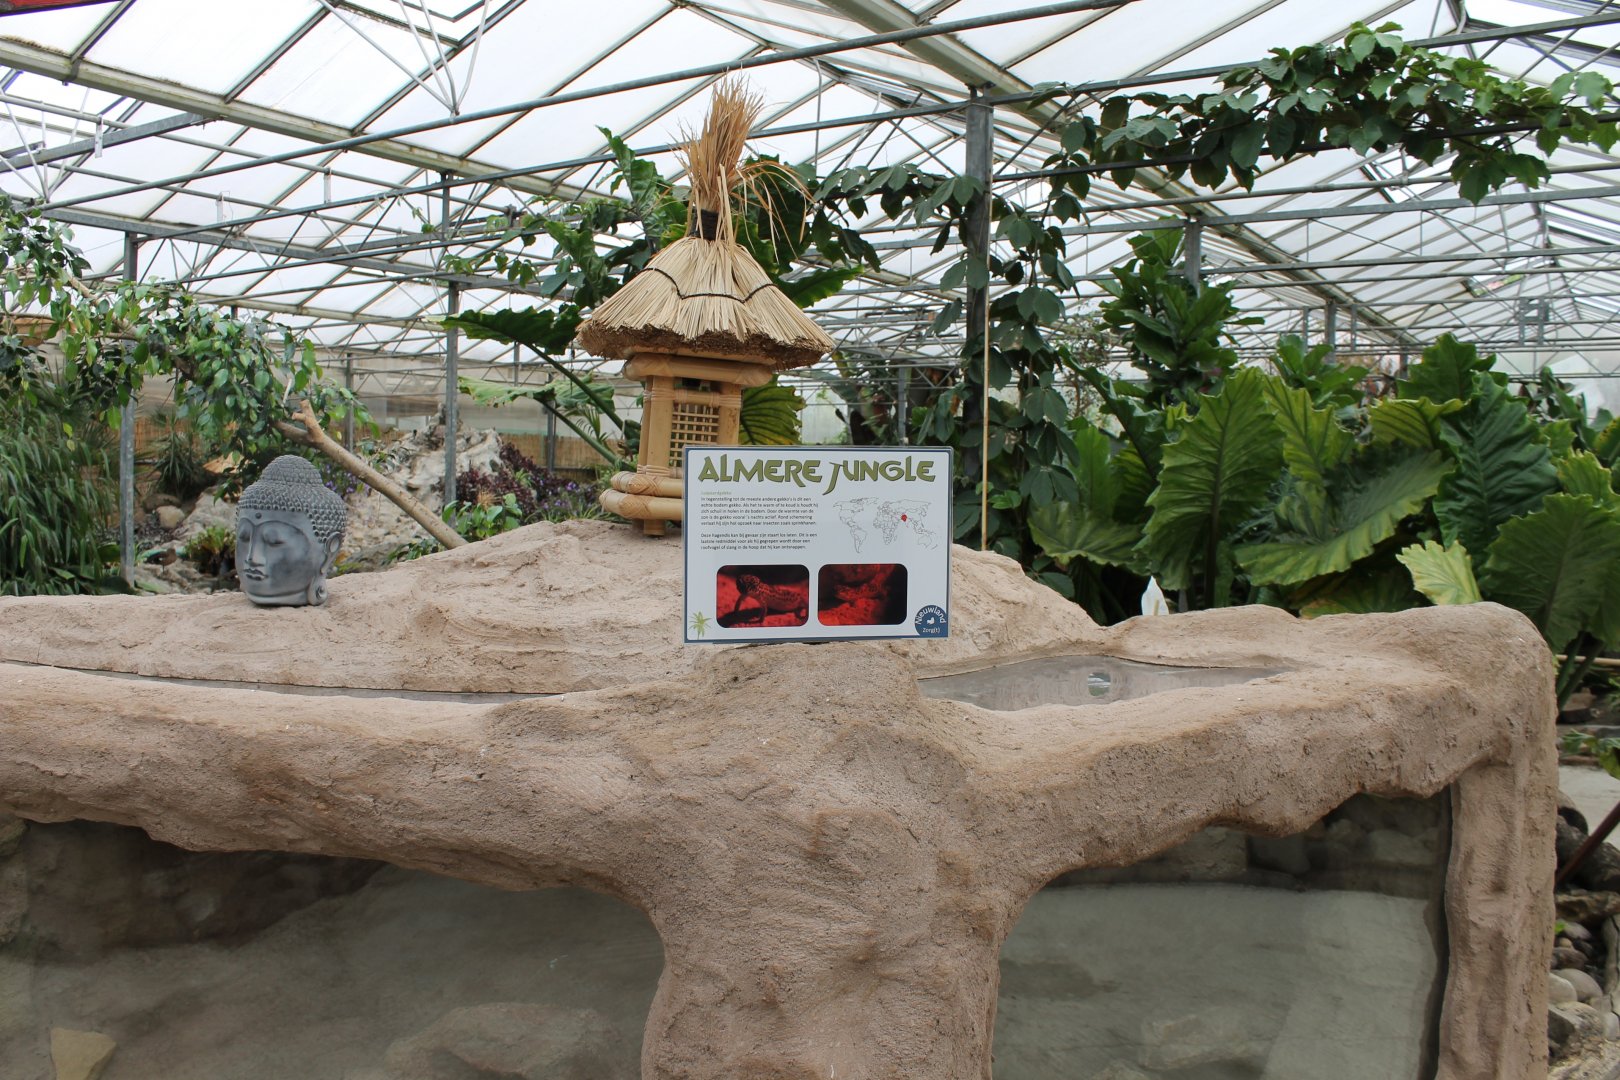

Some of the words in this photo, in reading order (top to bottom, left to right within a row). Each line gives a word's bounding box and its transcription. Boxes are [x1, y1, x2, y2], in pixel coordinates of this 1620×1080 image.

[698, 454, 822, 487] ALMERE
[822, 456, 936, 496] JUNGLE
[915, 606, 946, 624] Nieuwland
